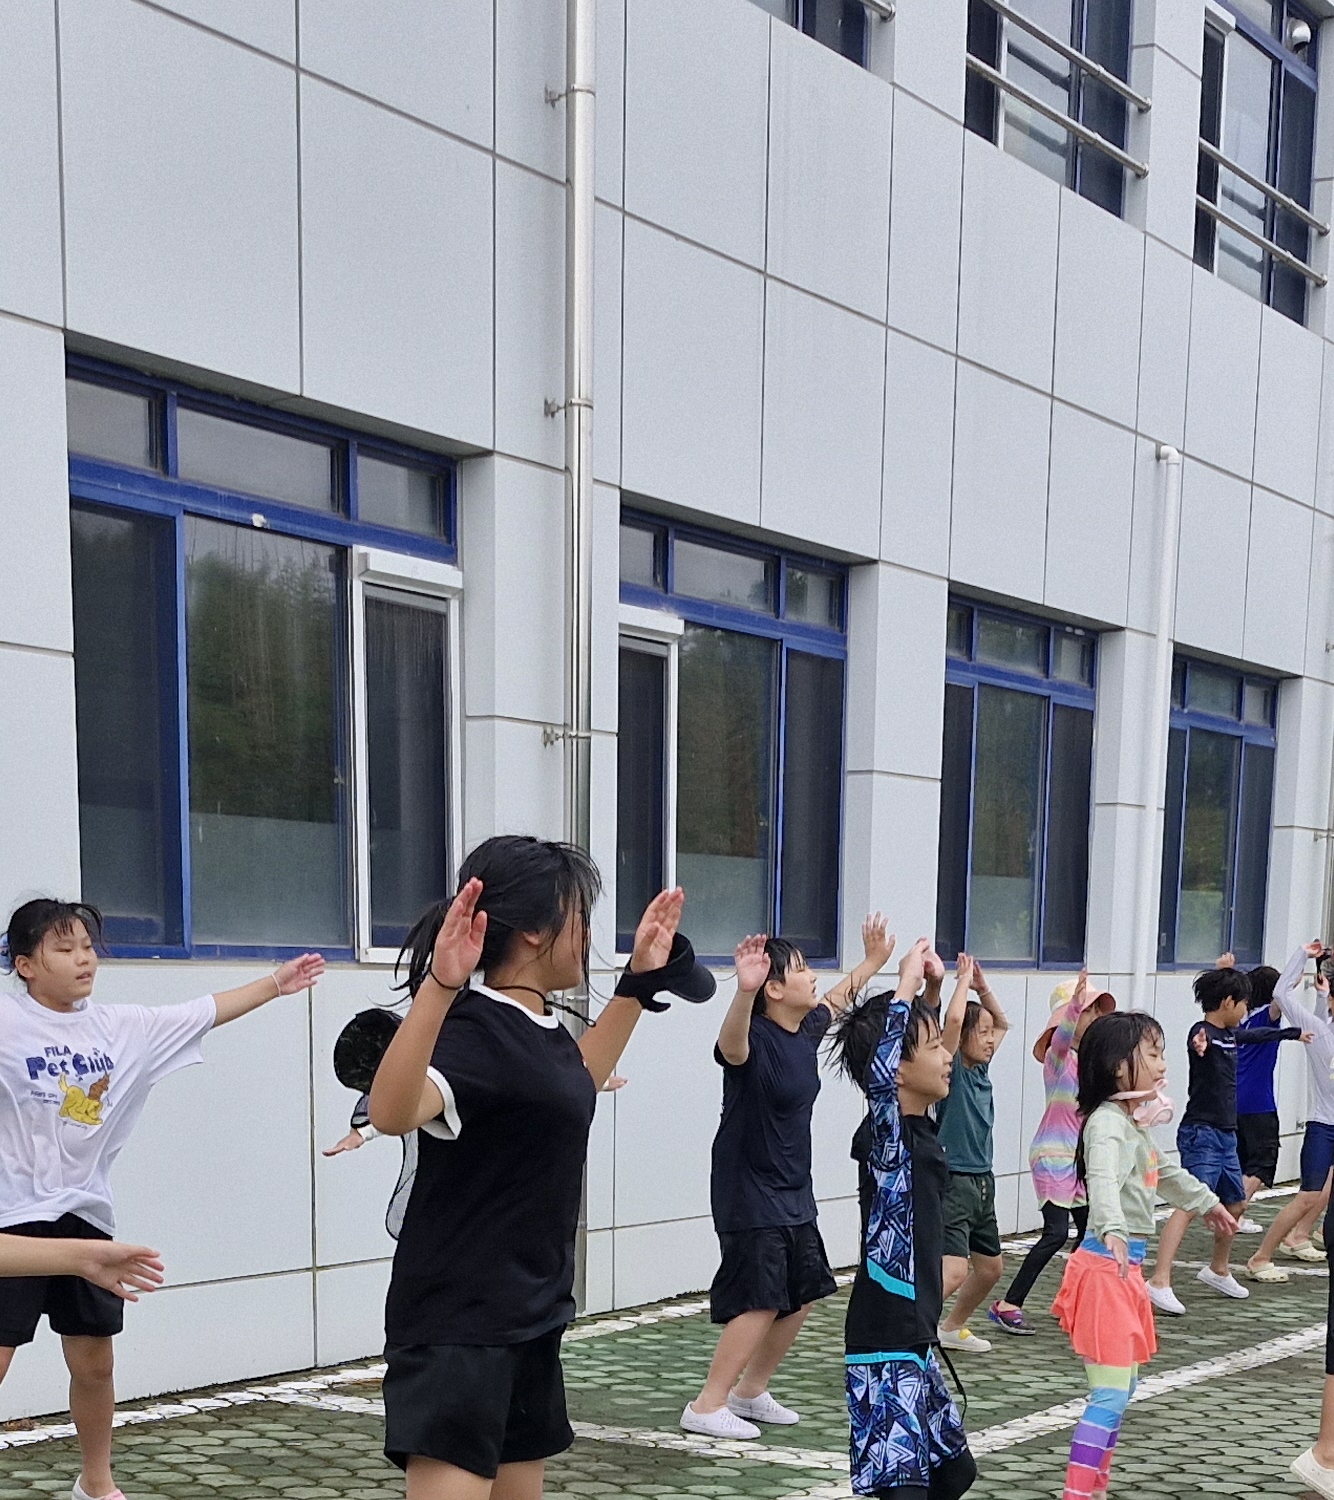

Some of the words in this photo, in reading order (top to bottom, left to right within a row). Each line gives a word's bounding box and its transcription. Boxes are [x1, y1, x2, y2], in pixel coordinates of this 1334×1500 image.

[44, 1045, 72, 1057] FILA
[25, 1056, 70, 1080] Pet
[72, 1051, 114, 1077] Club
